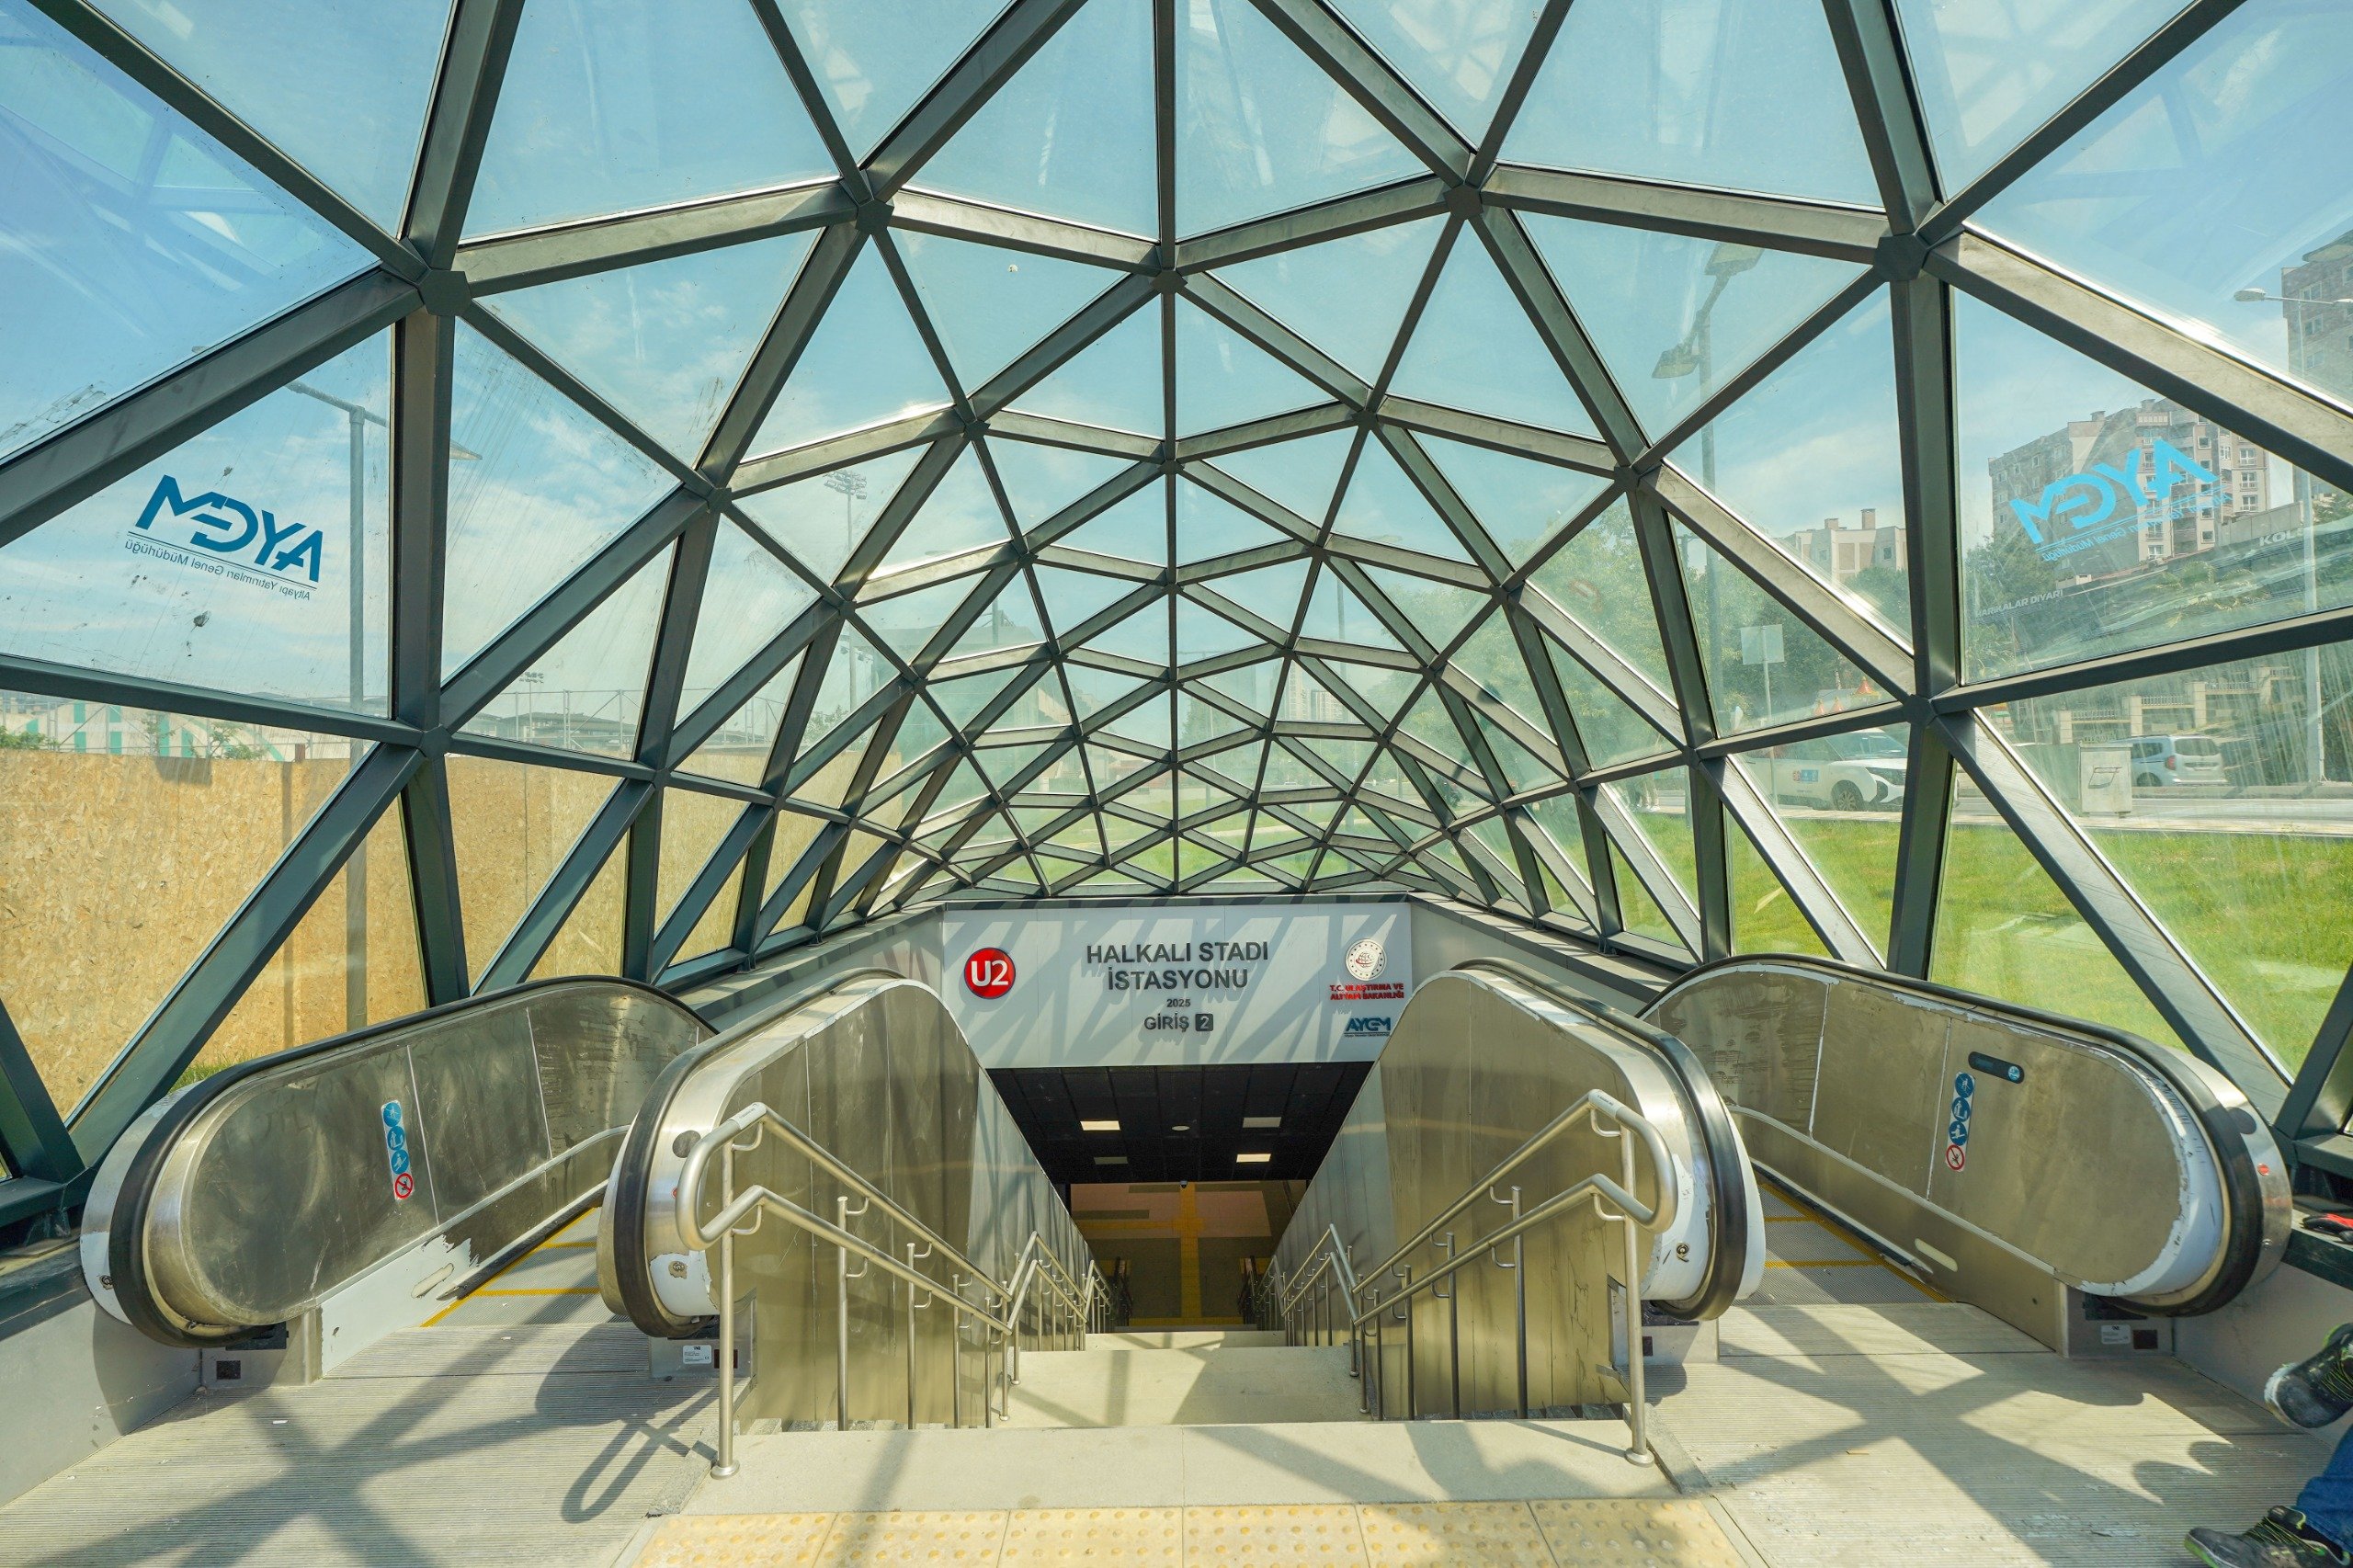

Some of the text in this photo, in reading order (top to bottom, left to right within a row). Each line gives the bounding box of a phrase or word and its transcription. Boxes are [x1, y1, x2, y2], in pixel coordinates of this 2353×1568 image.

[1086, 941, 1268, 963] HALKALI STADI
[971, 960, 1009, 987] U2
[1108, 966, 1248, 990] İSTASYONU
[1166, 998, 1191, 1007] 2025
[1143, 1013, 1210, 1032] GİRİŞ 2
